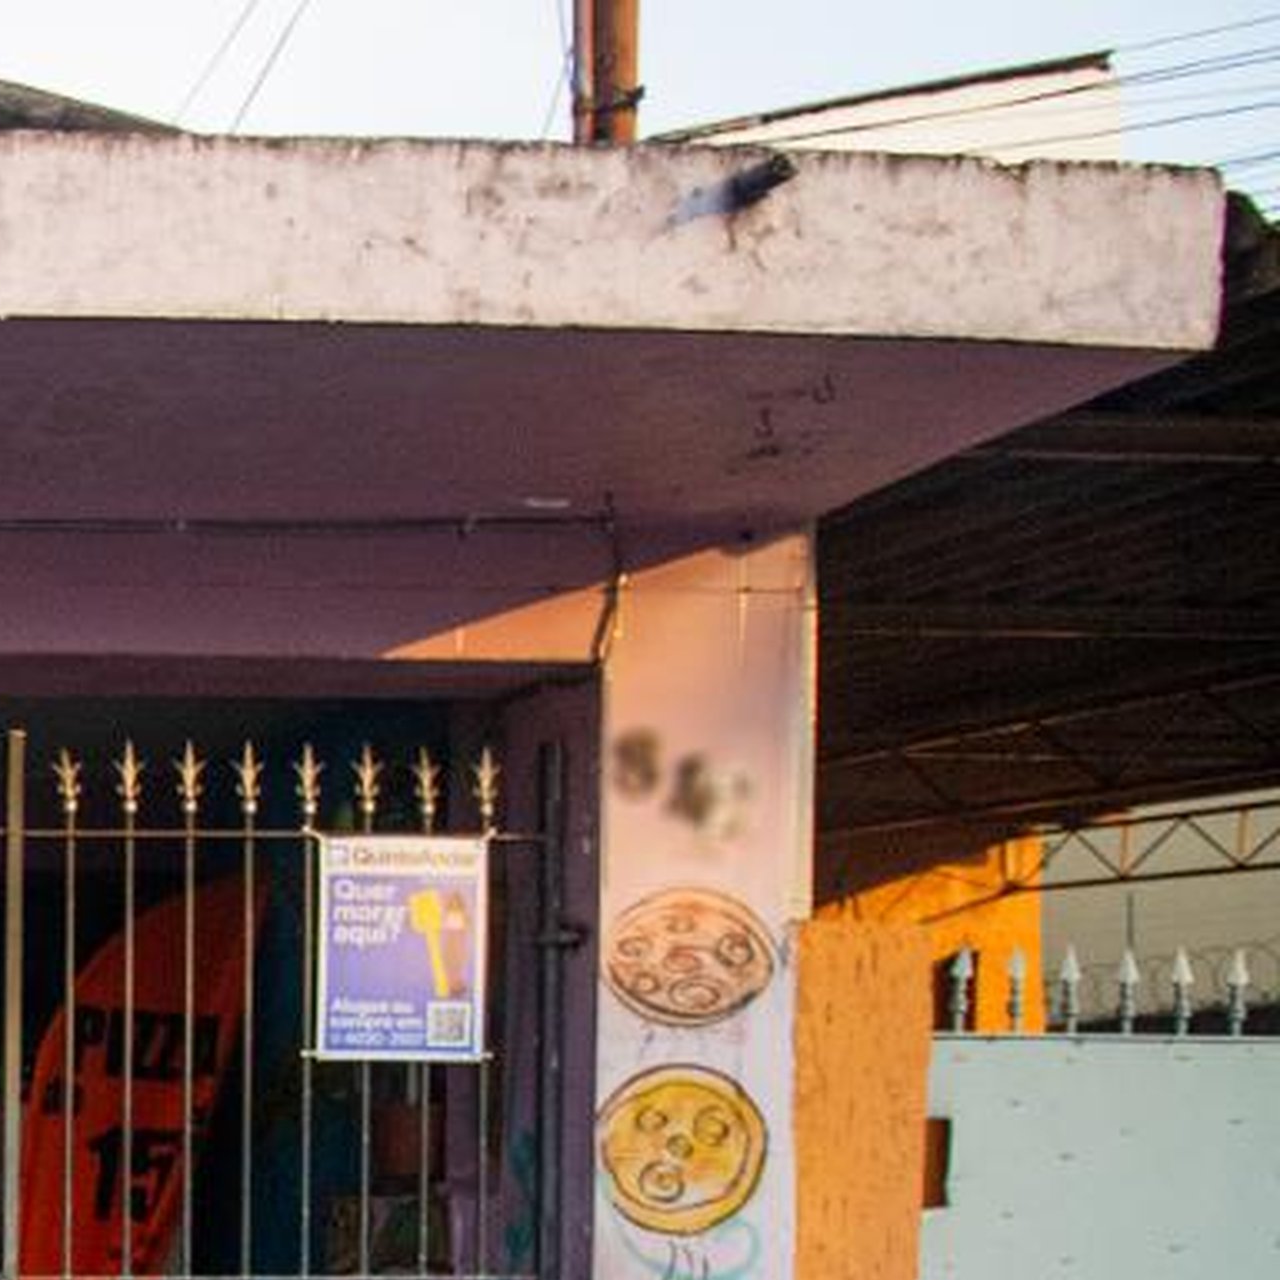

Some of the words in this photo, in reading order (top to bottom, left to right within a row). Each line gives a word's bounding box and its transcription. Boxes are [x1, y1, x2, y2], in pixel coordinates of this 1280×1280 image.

[333, 878, 397, 900] Quer
[333, 905, 406, 922] morar
[333, 921, 402, 948] aqui?
